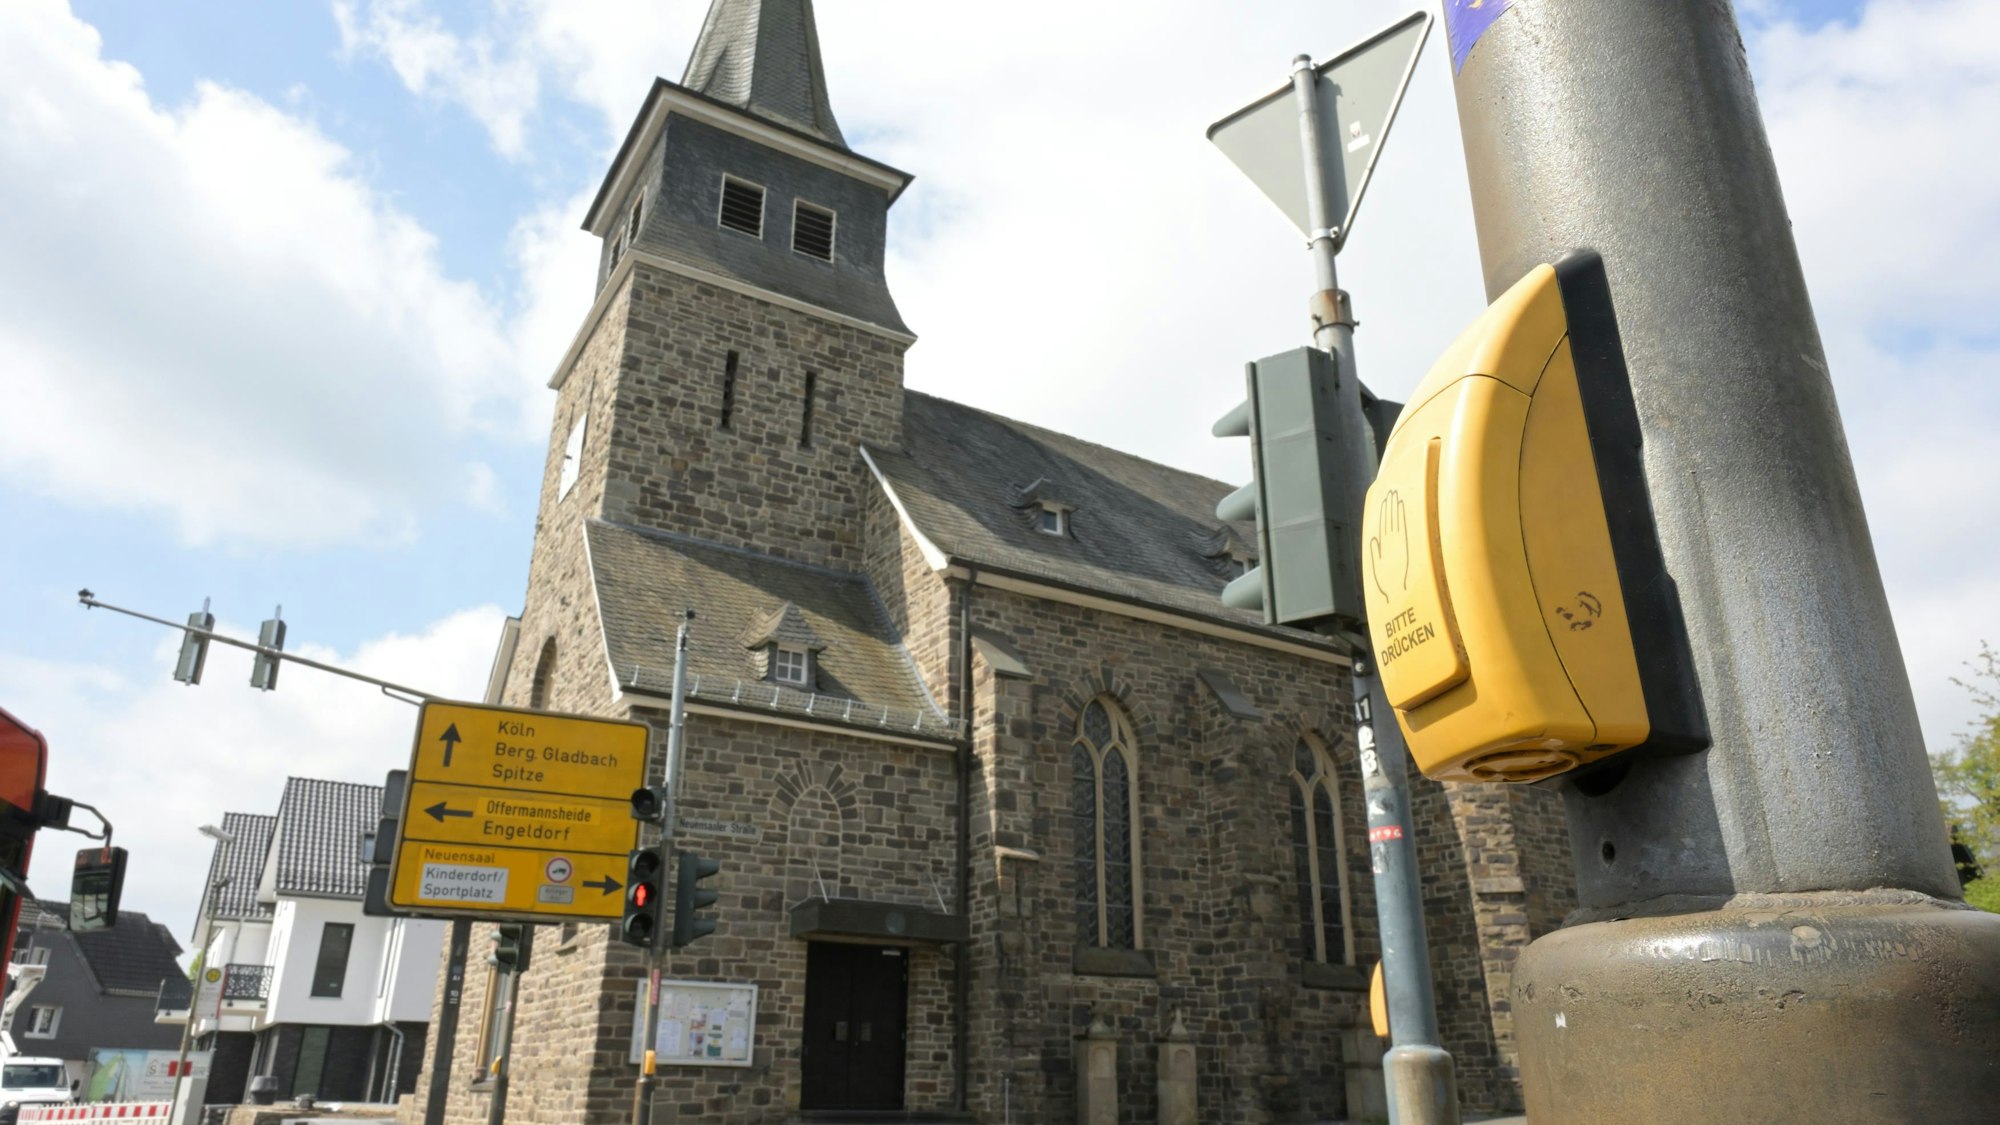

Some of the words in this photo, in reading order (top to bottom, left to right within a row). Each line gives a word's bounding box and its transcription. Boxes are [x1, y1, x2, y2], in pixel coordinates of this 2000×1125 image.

[1385, 607, 1416, 639] BITTE
[1381, 622, 1435, 667] DRÜCKEN
[498, 721, 535, 737] Köln
[543, 747, 617, 767] Gladbach
[492, 764, 544, 782] Spitze
[487, 800, 591, 822] Offermannsheide
[483, 820, 570, 840] Engeldorf
[425, 848, 495, 863] Neuensaal
[426, 867, 504, 883] Kinderdorf/
[424, 883, 494, 899] Sportplatz
